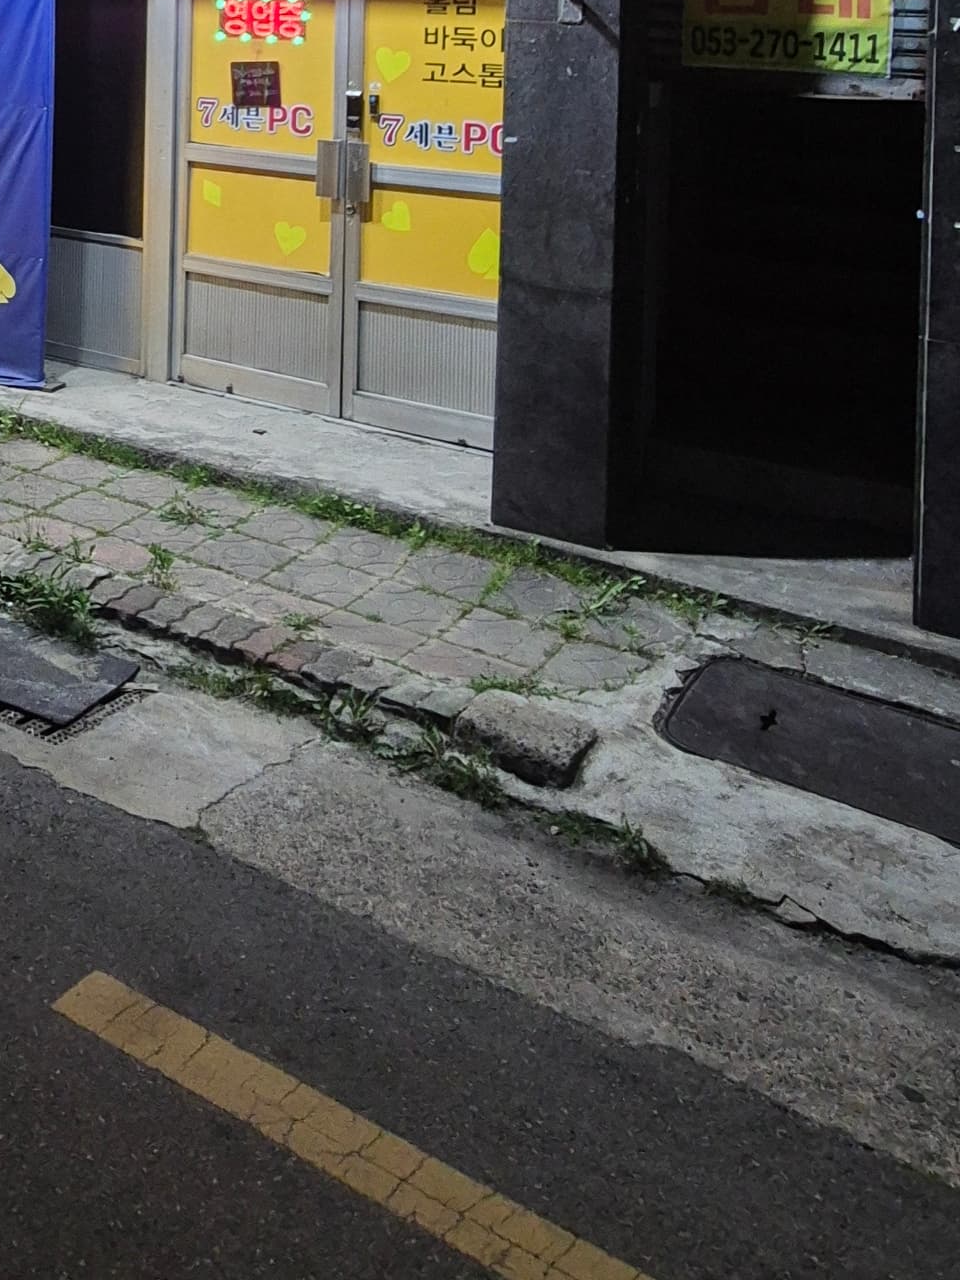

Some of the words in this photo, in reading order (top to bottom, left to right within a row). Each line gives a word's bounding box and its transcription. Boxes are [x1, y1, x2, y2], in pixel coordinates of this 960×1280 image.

[224, 0, 304, 38] 영업중
[423, 26, 504, 52] 바둑이
[691, 27, 880, 64] 053-270-1411
[422, 61, 503, 88] 고스톱
